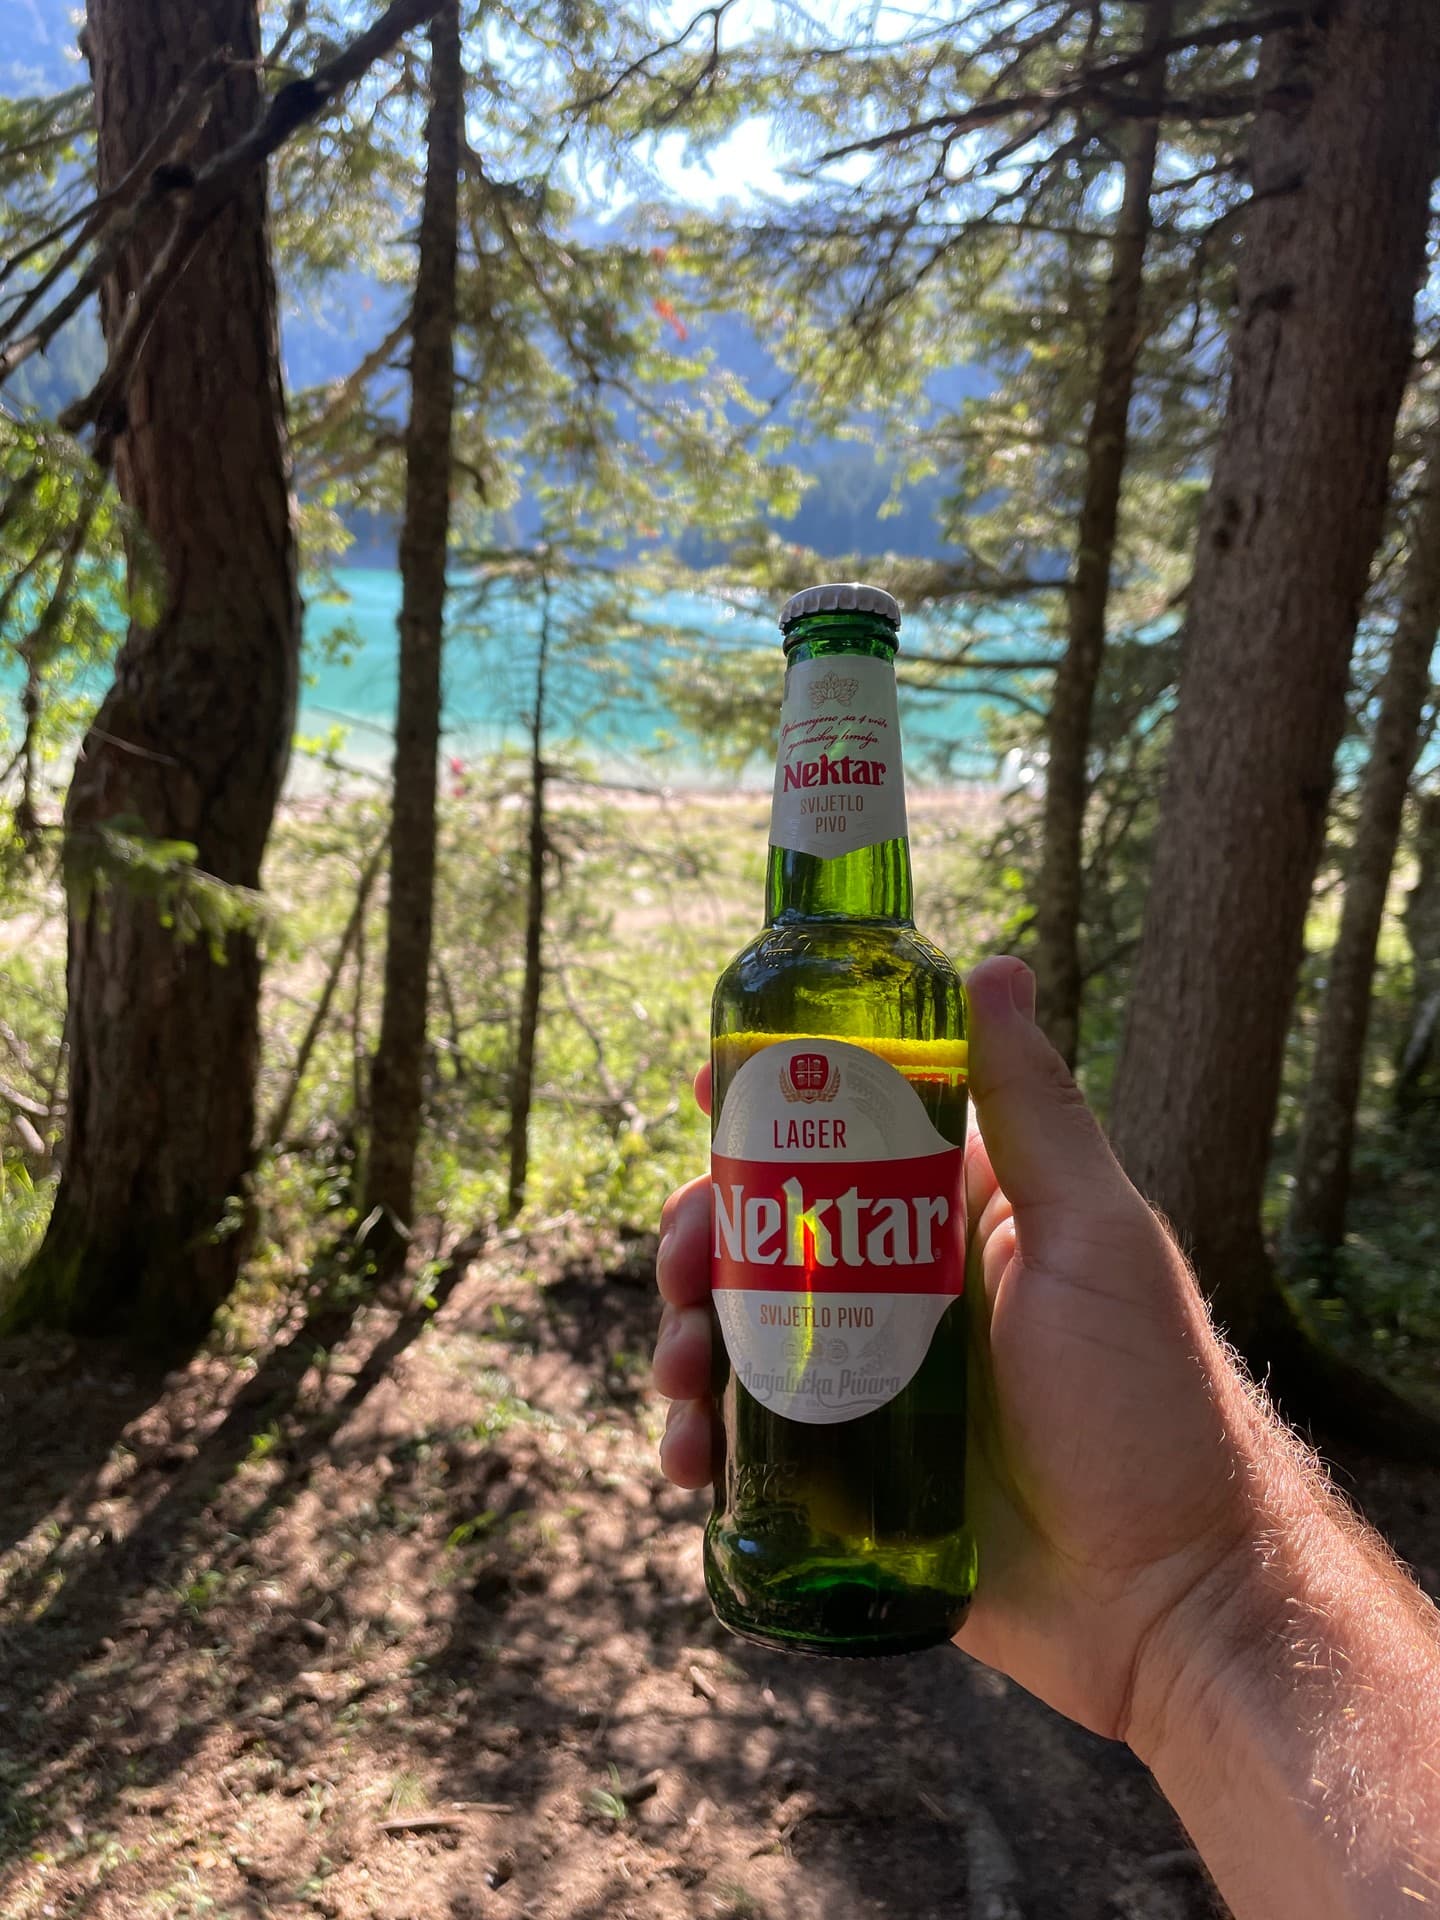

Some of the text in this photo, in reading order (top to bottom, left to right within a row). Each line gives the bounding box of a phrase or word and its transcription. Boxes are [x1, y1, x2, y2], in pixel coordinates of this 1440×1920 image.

[838, 714, 856, 725] sa
[858, 714, 867, 724] 4
[783, 754, 887, 793] Nektar
[801, 795, 864, 815] SVIJETLO
[815, 815, 847, 833] PIVO
[773, 1119, 847, 1149] LAGER
[712, 1176, 949, 1267] Nektar
[760, 1304, 874, 1328] SVIJETLO PIVO
